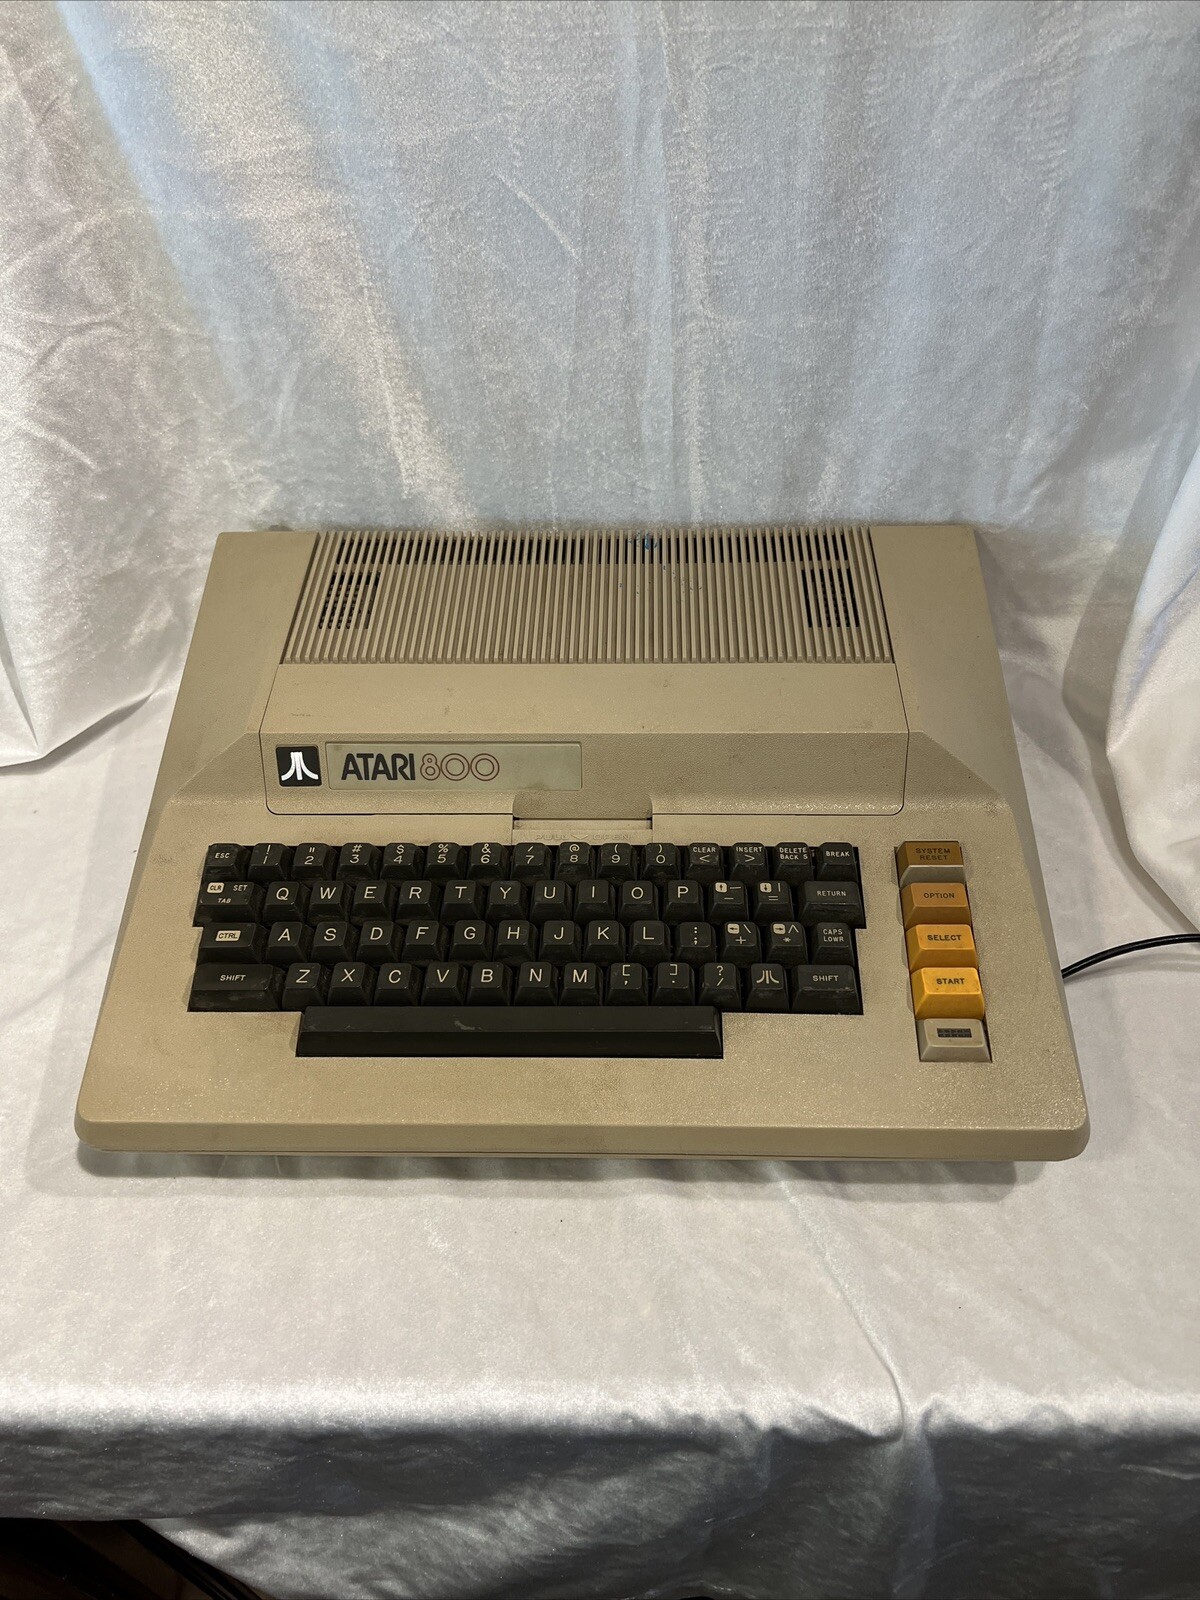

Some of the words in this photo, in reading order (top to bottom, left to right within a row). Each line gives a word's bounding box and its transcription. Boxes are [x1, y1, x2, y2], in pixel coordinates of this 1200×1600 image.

[341, 753, 416, 781] ATARI
[420, 753, 500, 781] 800
[266, 844, 271, 855] !
[352, 844, 362, 852] #
[396, 844, 405, 854] $
[438, 843, 448, 853] %
[481, 843, 491, 853] &
[569, 844, 580, 853] @
[614, 844, 619, 853] (
[658, 844, 663, 853] )
[304, 856, 314, 865] 2
[350, 854, 360, 864] 3
[393, 855, 403, 864] 4
[437, 854, 447, 864] 5
[480, 854, 490, 864] 6
[526, 855, 534, 864] 7
[569, 854, 578, 863] 8
[611, 854, 621, 863] 9
[744, 854, 755, 862] >
[276, 887, 289, 901] Q
[320, 887, 337, 899] W
[364, 886, 377, 899] E
[409, 887, 422, 899] R
[455, 886, 467, 898] T
[500, 887, 512, 899] Y
[544, 886, 556, 899] U
[591, 886, 595, 898] I
[631, 887, 644, 899] O
[677, 886, 689, 898] P
[277, 928, 291, 941] A
[324, 928, 337, 942] S
[370, 927, 383, 940] D
[415, 926, 429, 939] F
[463, 926, 476, 940] G
[507, 926, 520, 939] H
[553, 926, 564, 940] J
[597, 926, 610, 940] K
[643, 926, 655, 940] L
[735, 936, 746, 944] +
[295, 969, 310, 983] Z
[341, 968, 356, 982] X
[388, 970, 401, 983] C
[436, 969, 450, 983] V
[481, 968, 493, 983] B
[529, 968, 543, 982] N
[572, 969, 587, 983] M
[716, 965, 724, 976] ?
